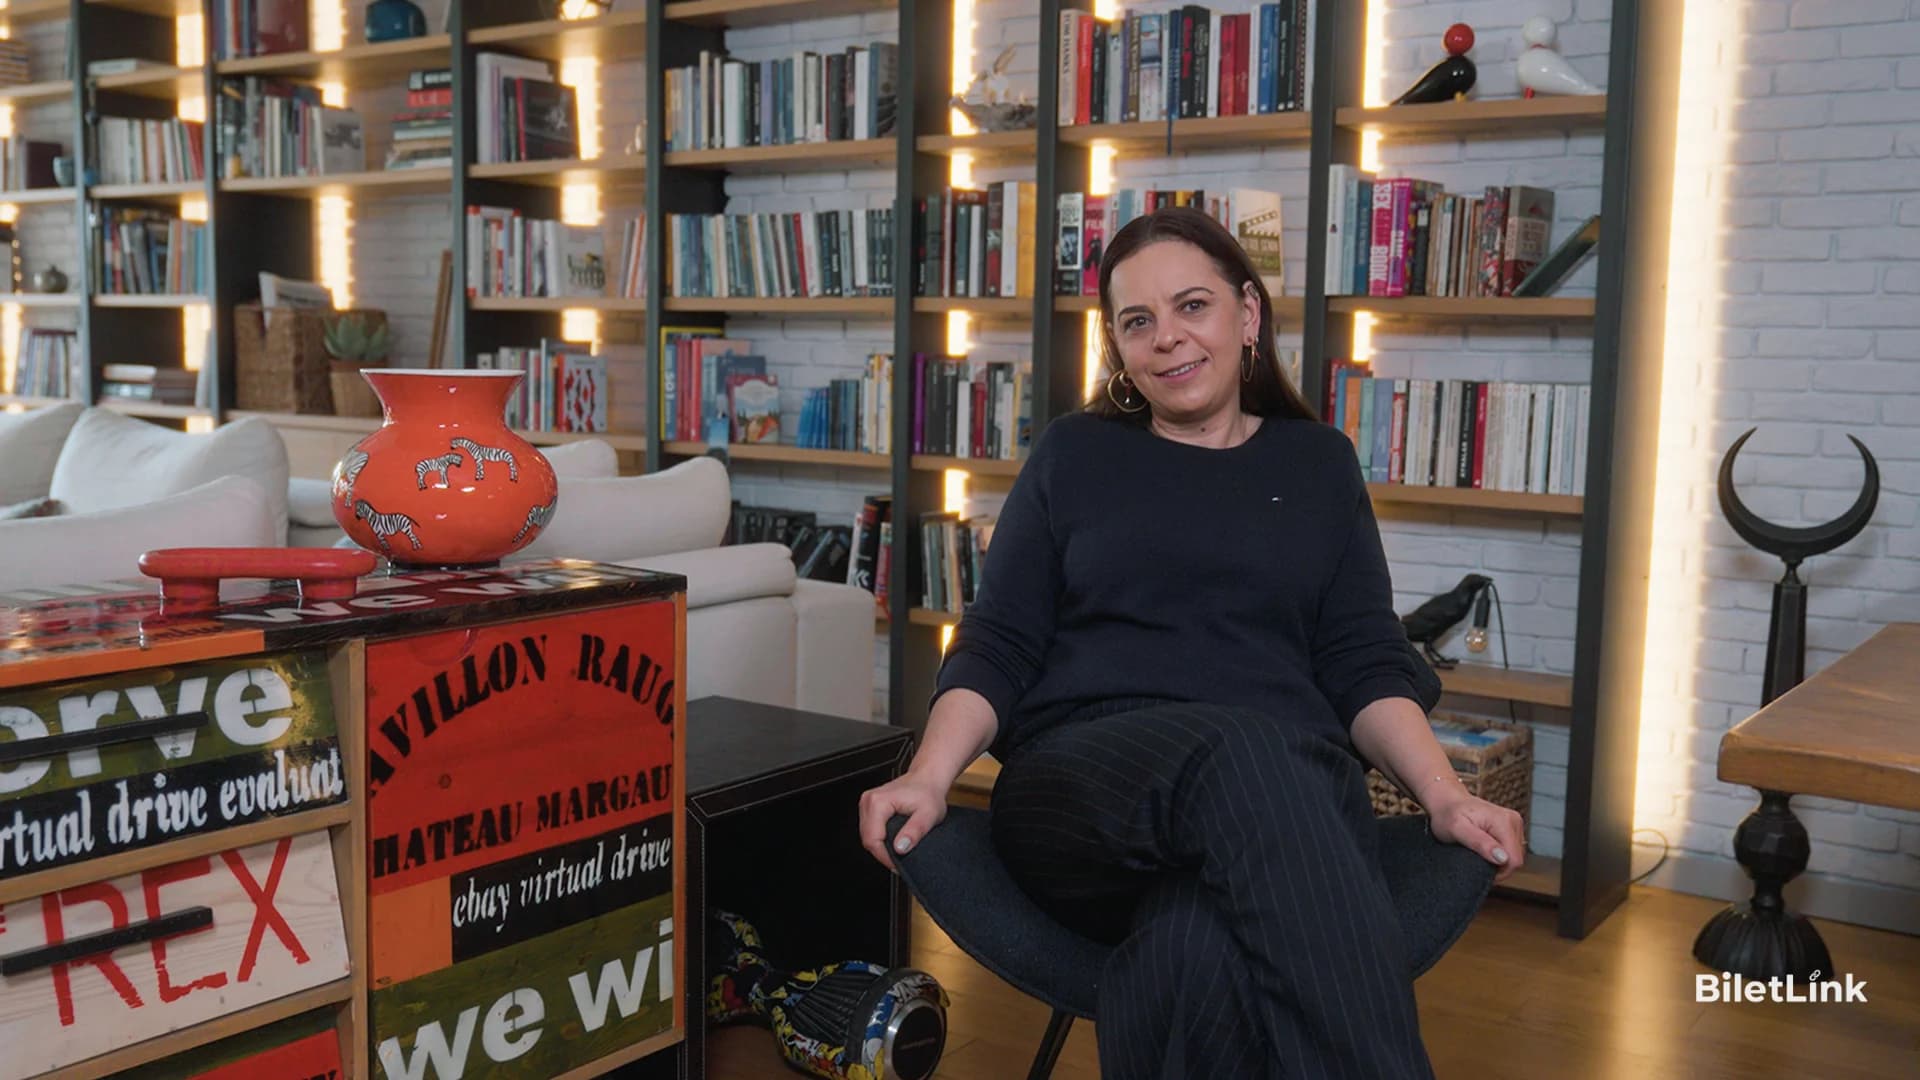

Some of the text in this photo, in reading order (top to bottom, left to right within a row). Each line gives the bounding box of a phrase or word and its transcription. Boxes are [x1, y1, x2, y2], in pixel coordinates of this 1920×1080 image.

[1373, 183, 1392, 210] SEX
[1369, 245, 1389, 281] BOOK
[106, 772, 208, 845] drive
[373, 763, 673, 879] HATEAU MARGAU
[520, 842, 604, 908] virtual
[610, 828, 672, 881] drive
[41, 837, 311, 1027] REX
[377, 987, 545, 1080] we
